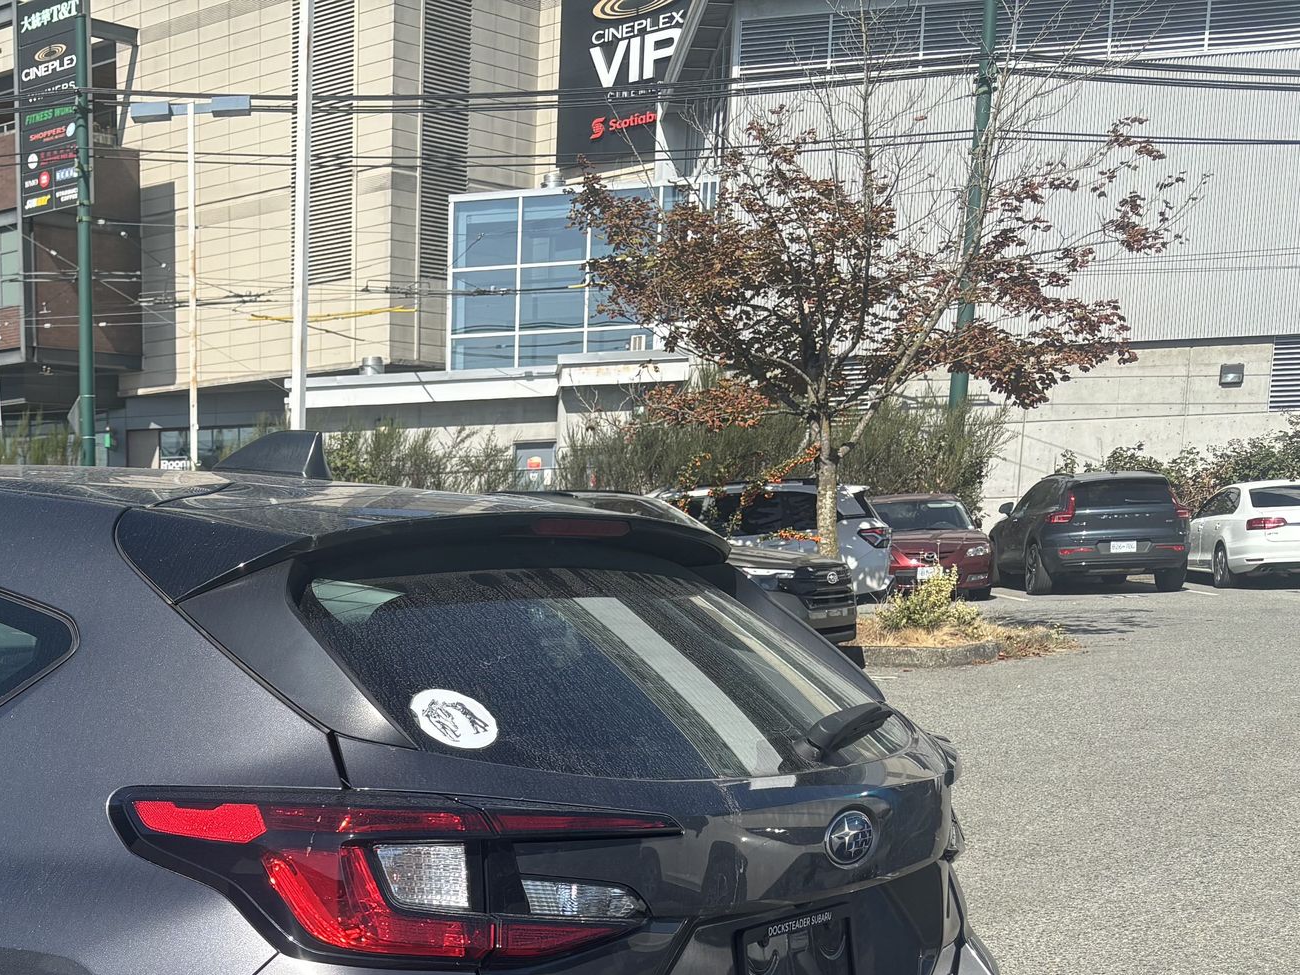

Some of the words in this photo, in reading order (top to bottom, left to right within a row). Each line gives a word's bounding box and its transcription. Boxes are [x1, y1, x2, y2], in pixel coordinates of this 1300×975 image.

[591, 9, 685, 45] CINEPLEX
[589, 28, 683, 88] VIP
[29, 125, 67, 142] SHOPPERS
[768, 917, 811, 937] DOCKSTEADER
[811, 911, 832, 925] SUBARU
